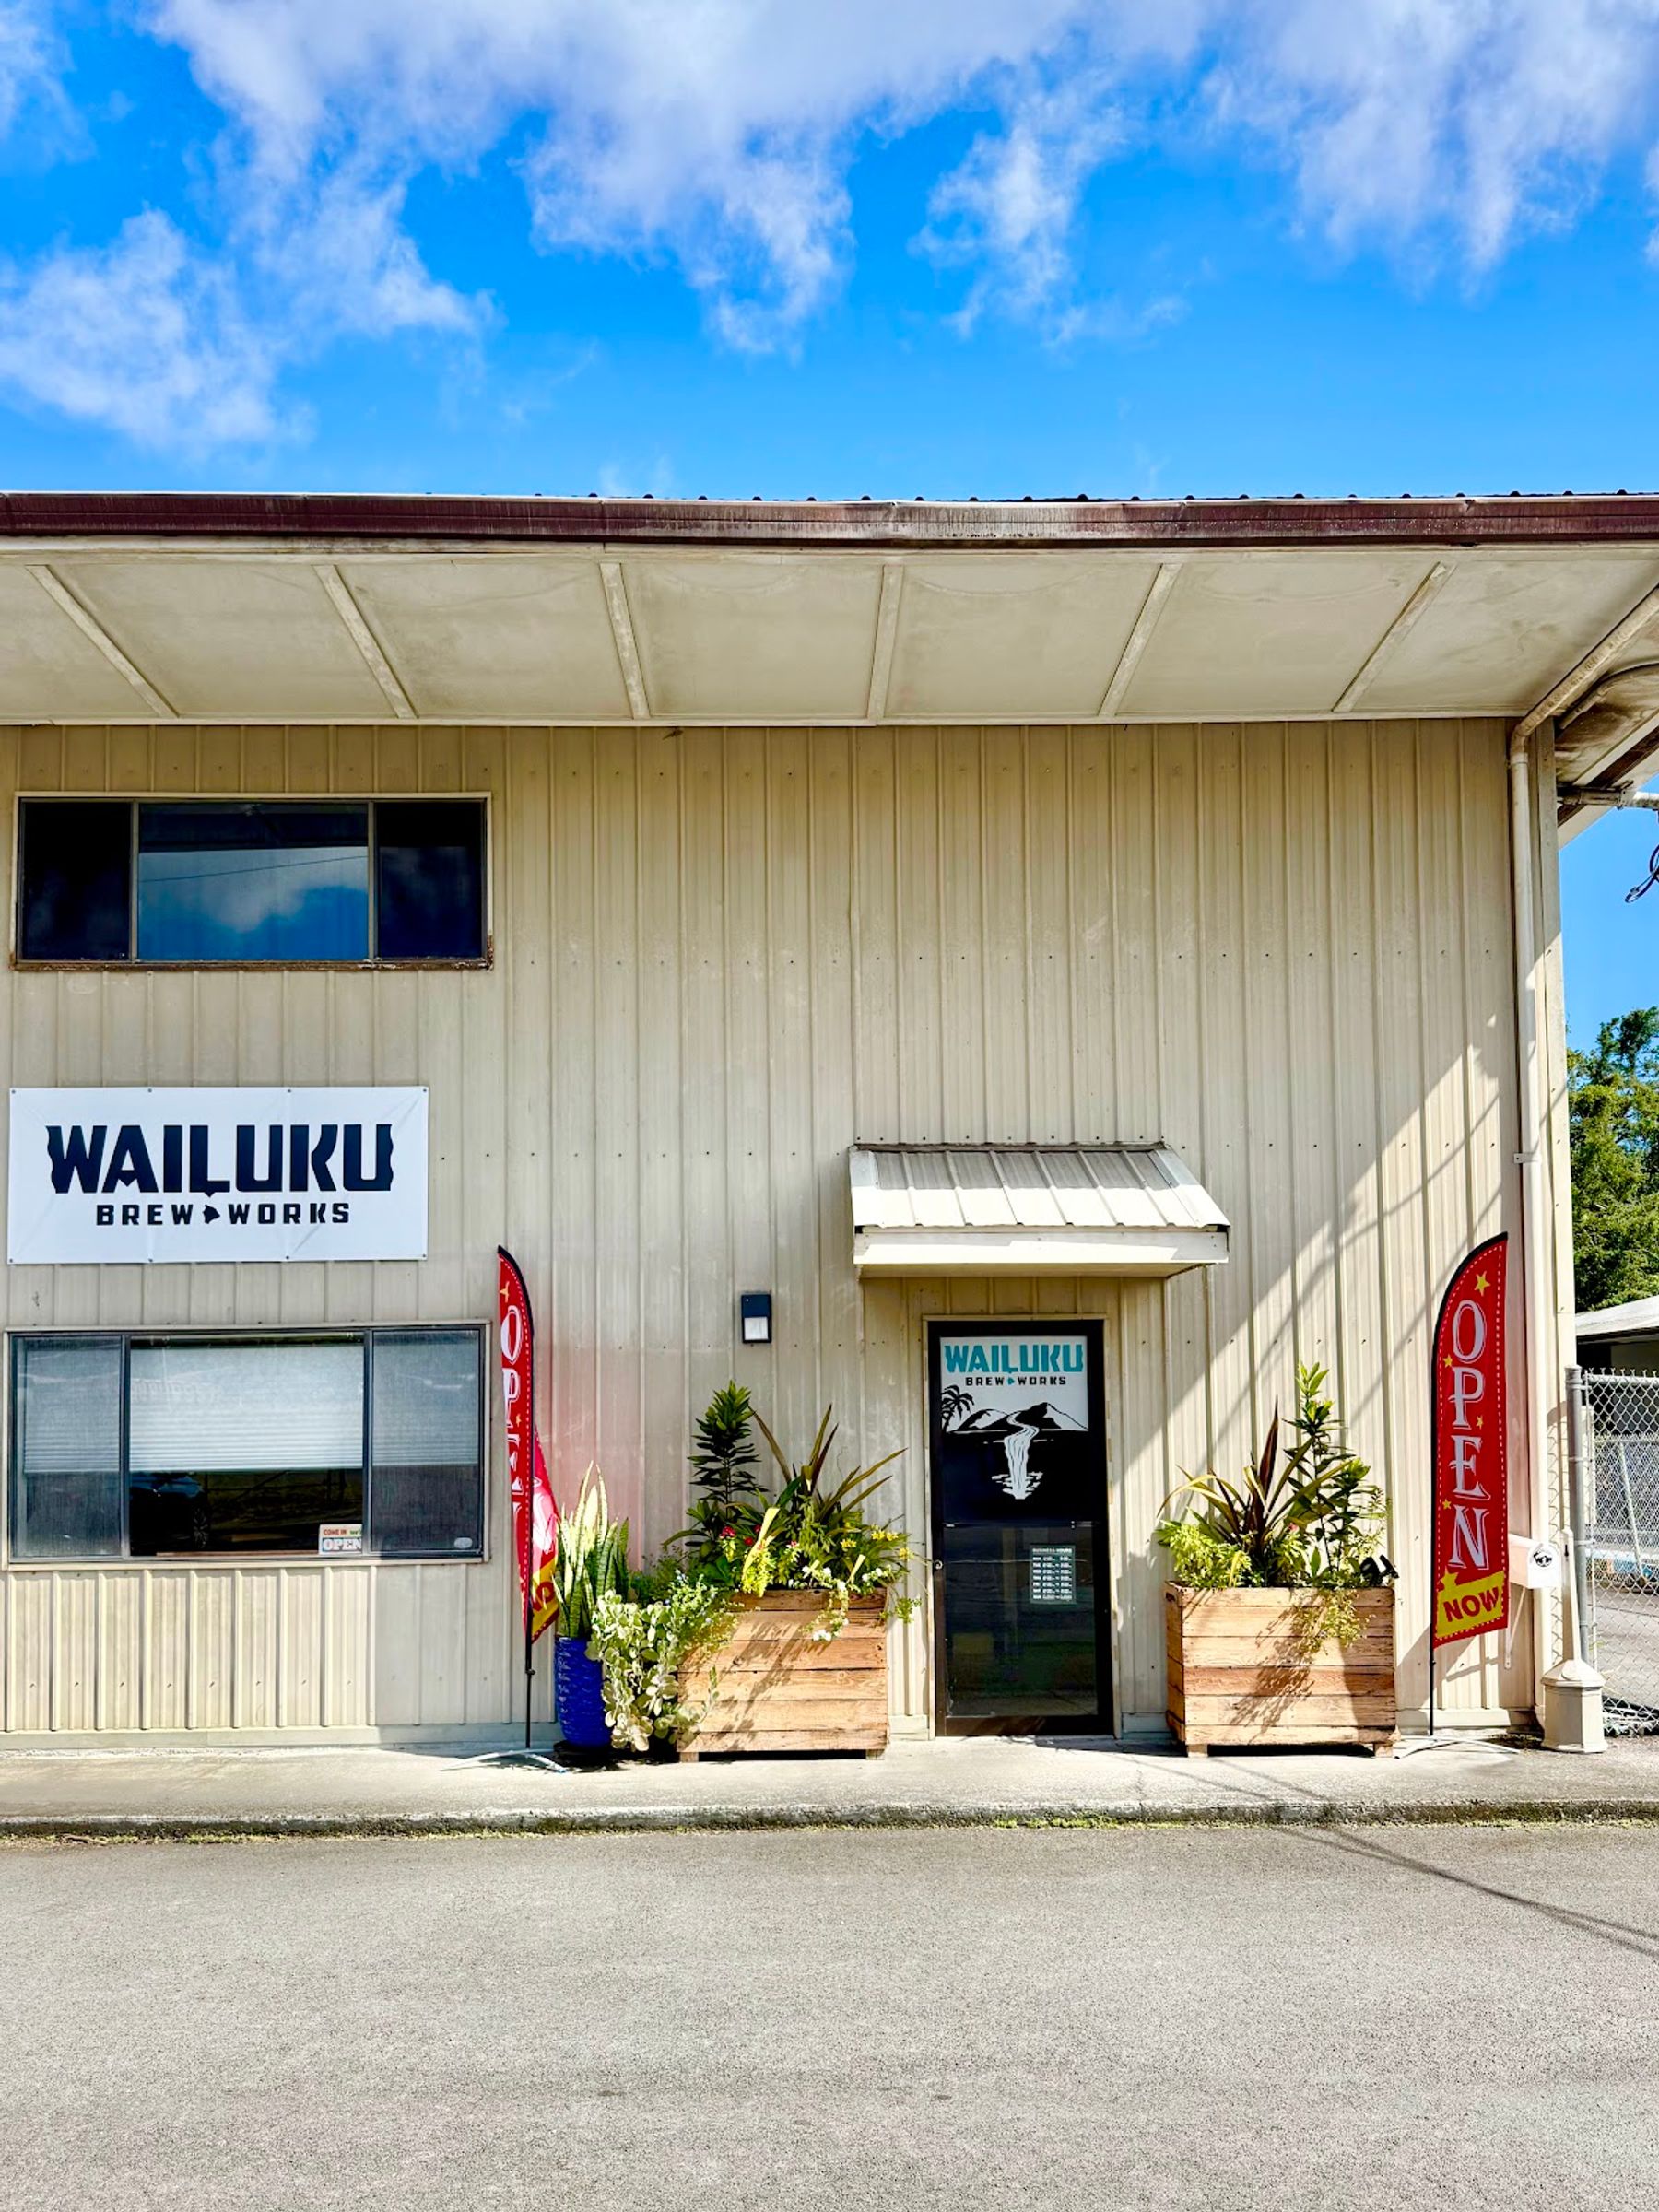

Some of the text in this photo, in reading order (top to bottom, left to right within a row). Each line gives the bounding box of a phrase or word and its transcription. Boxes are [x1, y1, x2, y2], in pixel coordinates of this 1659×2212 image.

[46, 1124, 394, 1197] WAILUKU
[96, 1202, 349, 1226] BREW WORKS
[945, 1345, 1084, 1373] WAILUKU
[966, 1376, 1066, 1386] BREW WORKS
[1449, 1300, 1490, 1571] OPEN
[323, 1538, 362, 1551] OPEN
[1443, 1586, 1500, 1622] NOW
